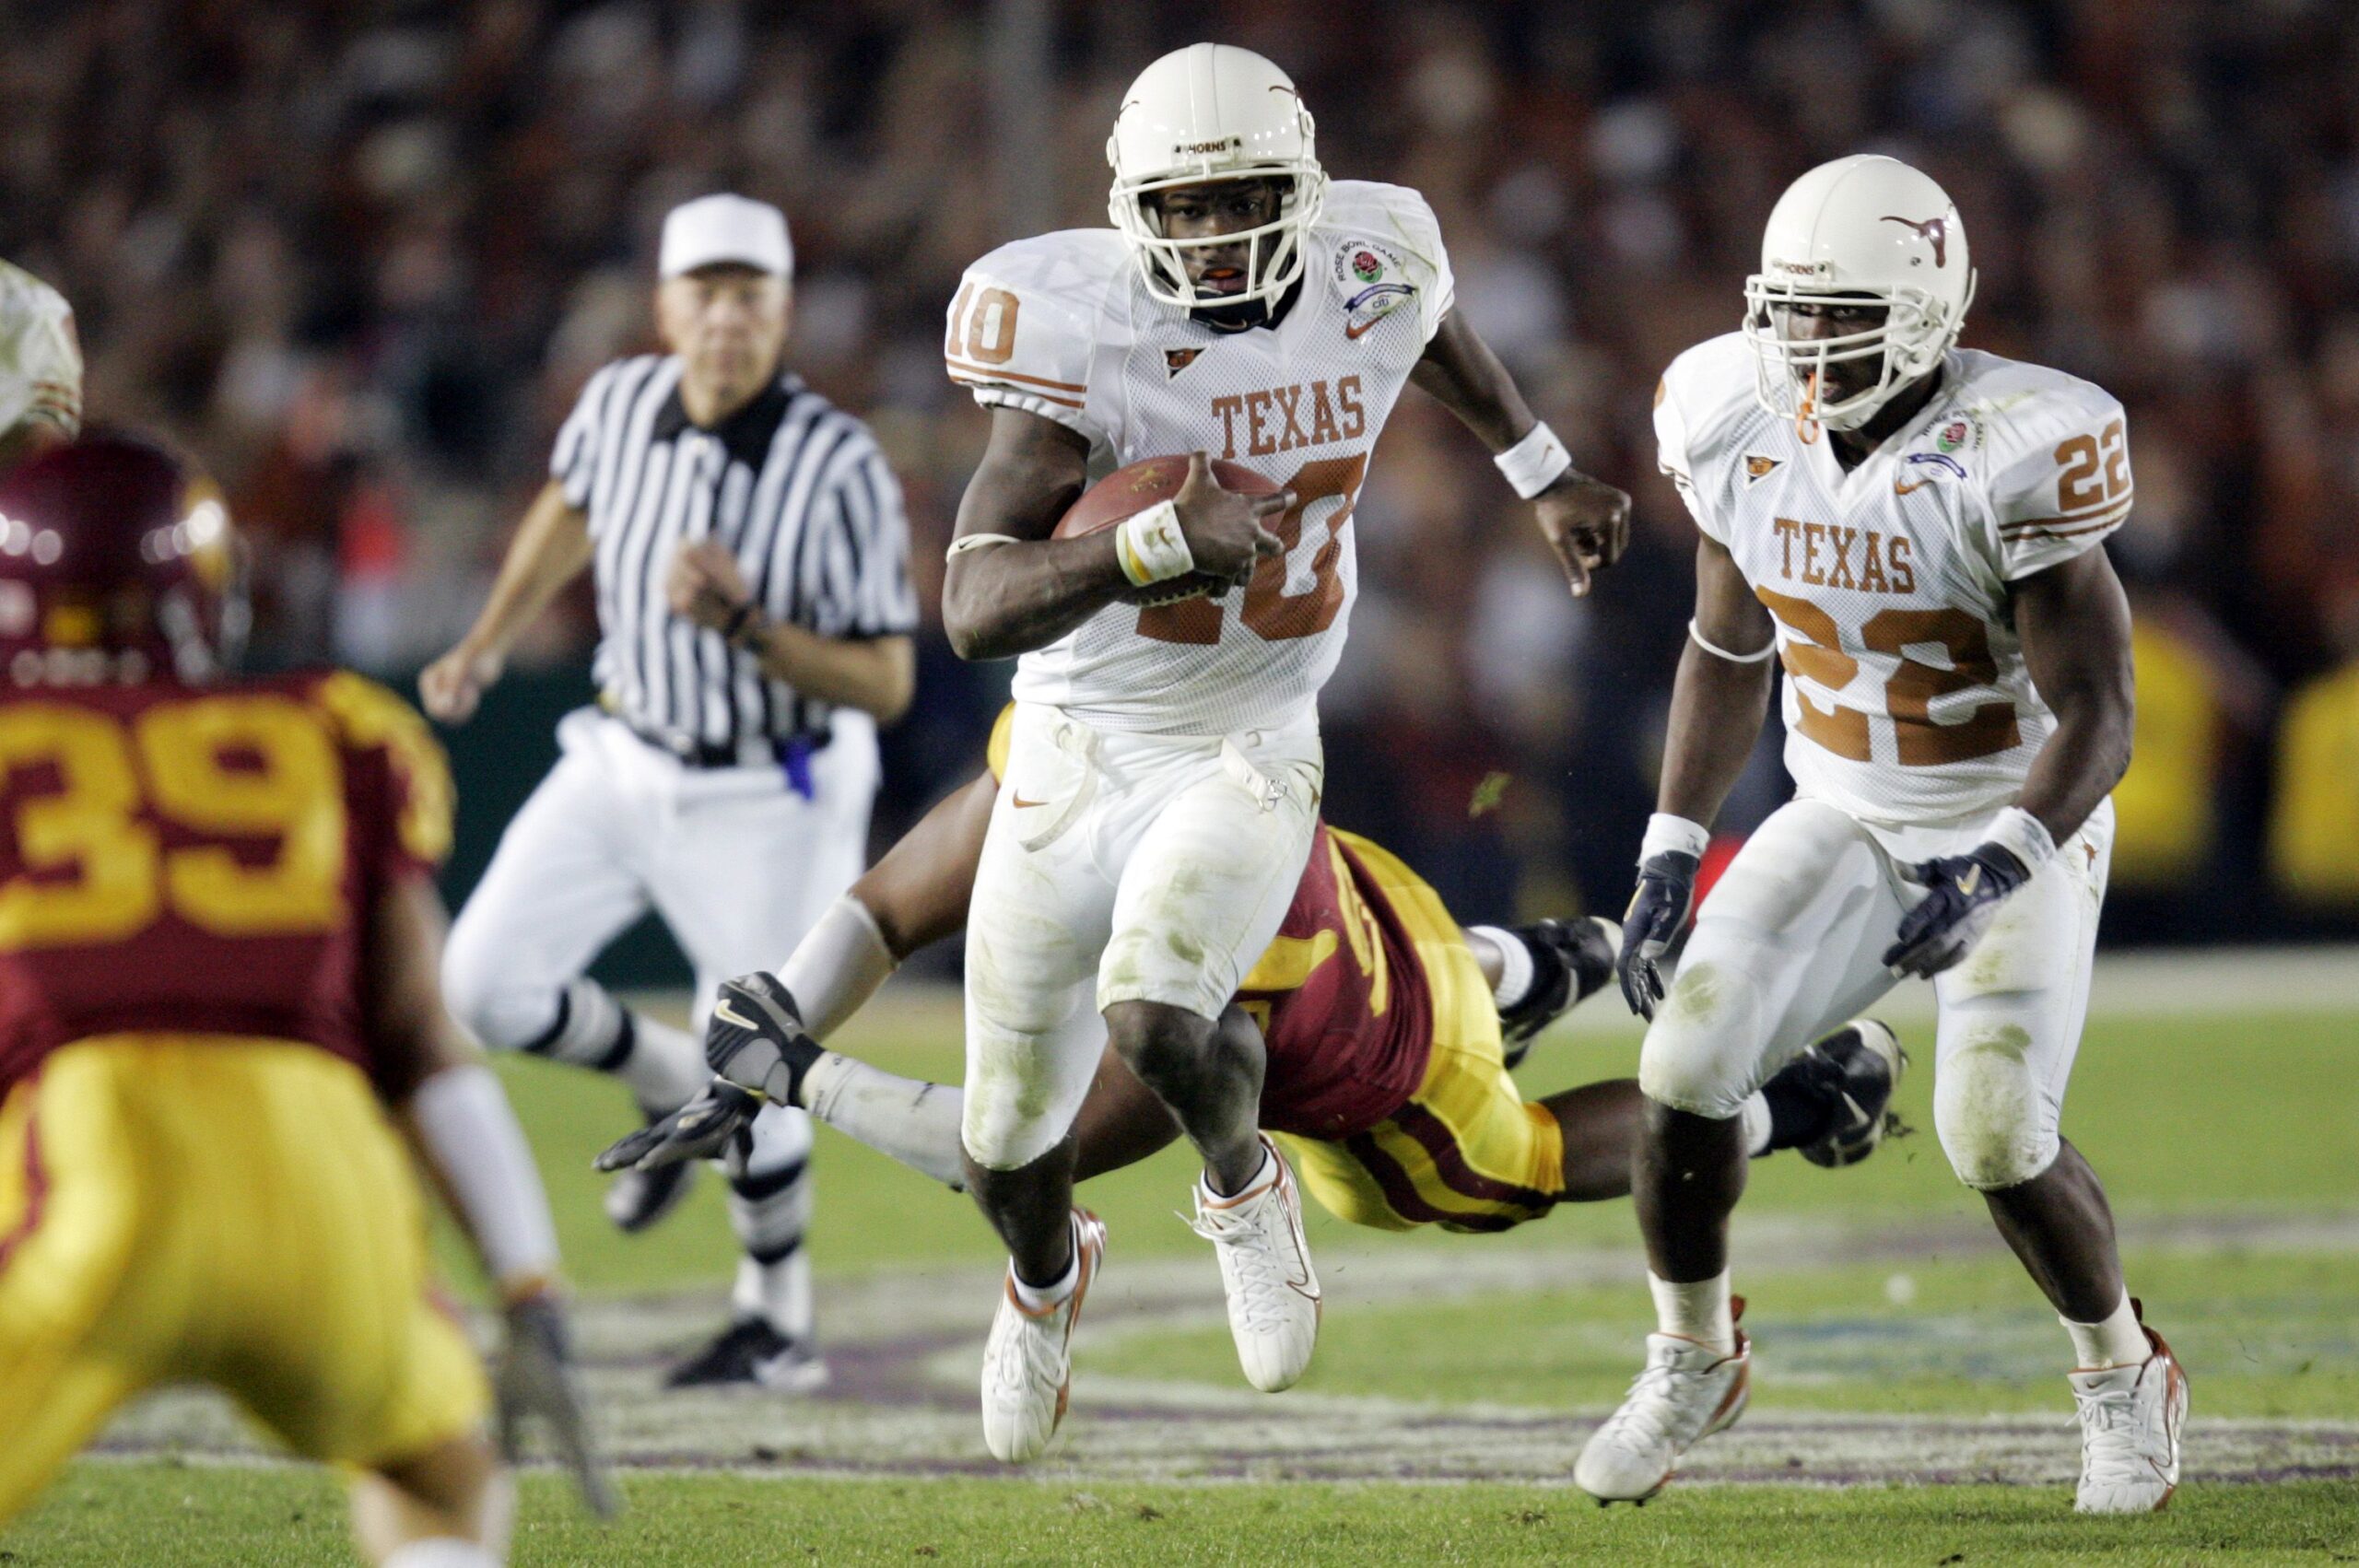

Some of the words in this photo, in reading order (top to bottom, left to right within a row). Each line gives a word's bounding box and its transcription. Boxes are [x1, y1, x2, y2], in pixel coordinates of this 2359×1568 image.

[1334, 252, 1346, 282] ROSE
[947, 281, 1020, 365] 10
[1211, 374, 1366, 460] TEXAS
[2053, 417, 2130, 512] 22
[1136, 451, 1367, 645] 0
[1774, 517, 1916, 593] TEXAS
[1755, 584, 2023, 766] 22
[0, 698, 347, 952] 39
